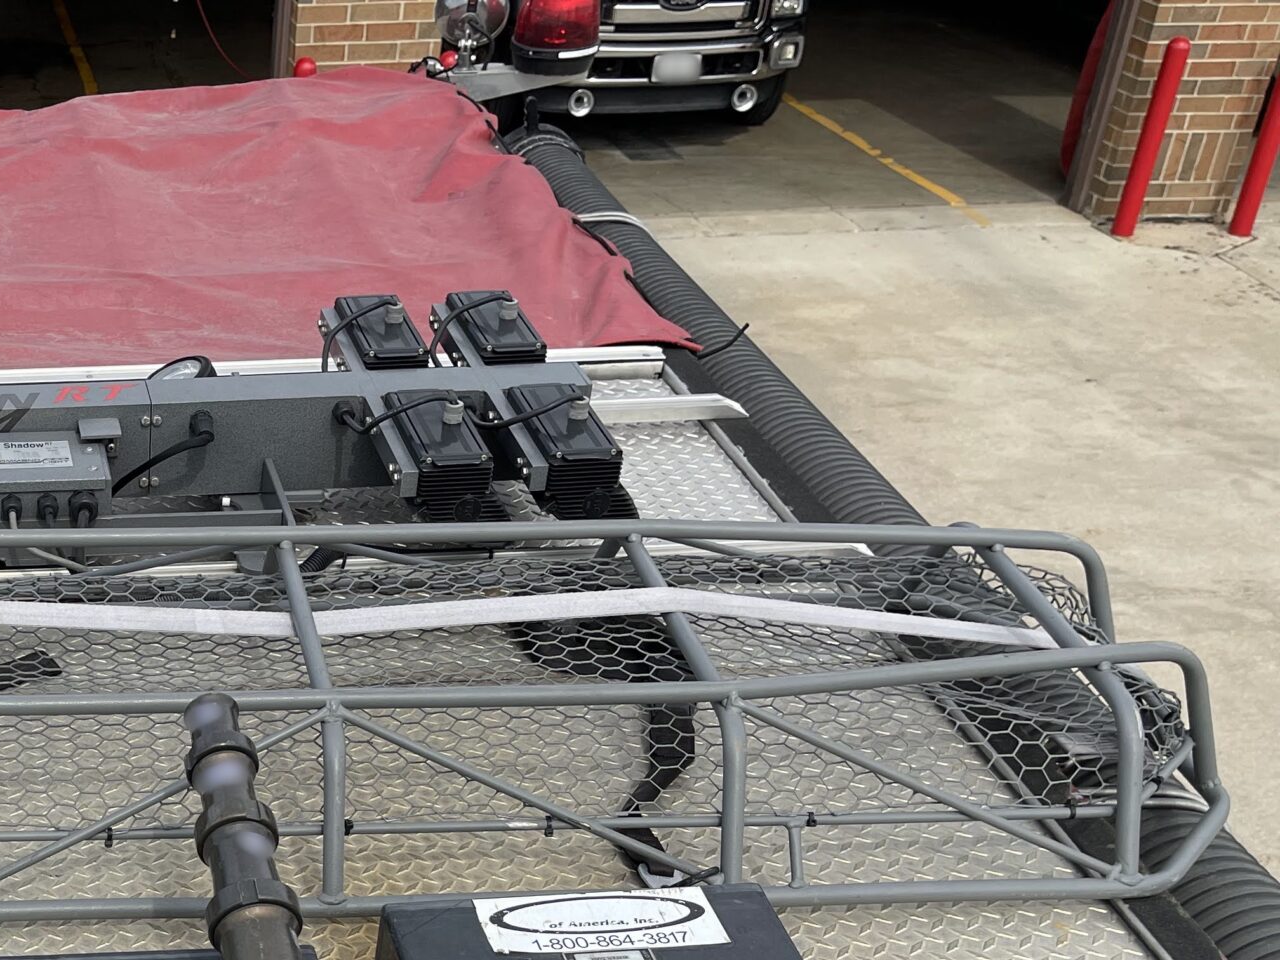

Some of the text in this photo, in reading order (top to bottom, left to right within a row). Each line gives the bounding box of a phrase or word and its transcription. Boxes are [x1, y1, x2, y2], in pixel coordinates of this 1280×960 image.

[52, 383, 139, 405] RT
[549, 920, 563, 929] of
[532, 930, 688, 951] 1-800-864-3817
